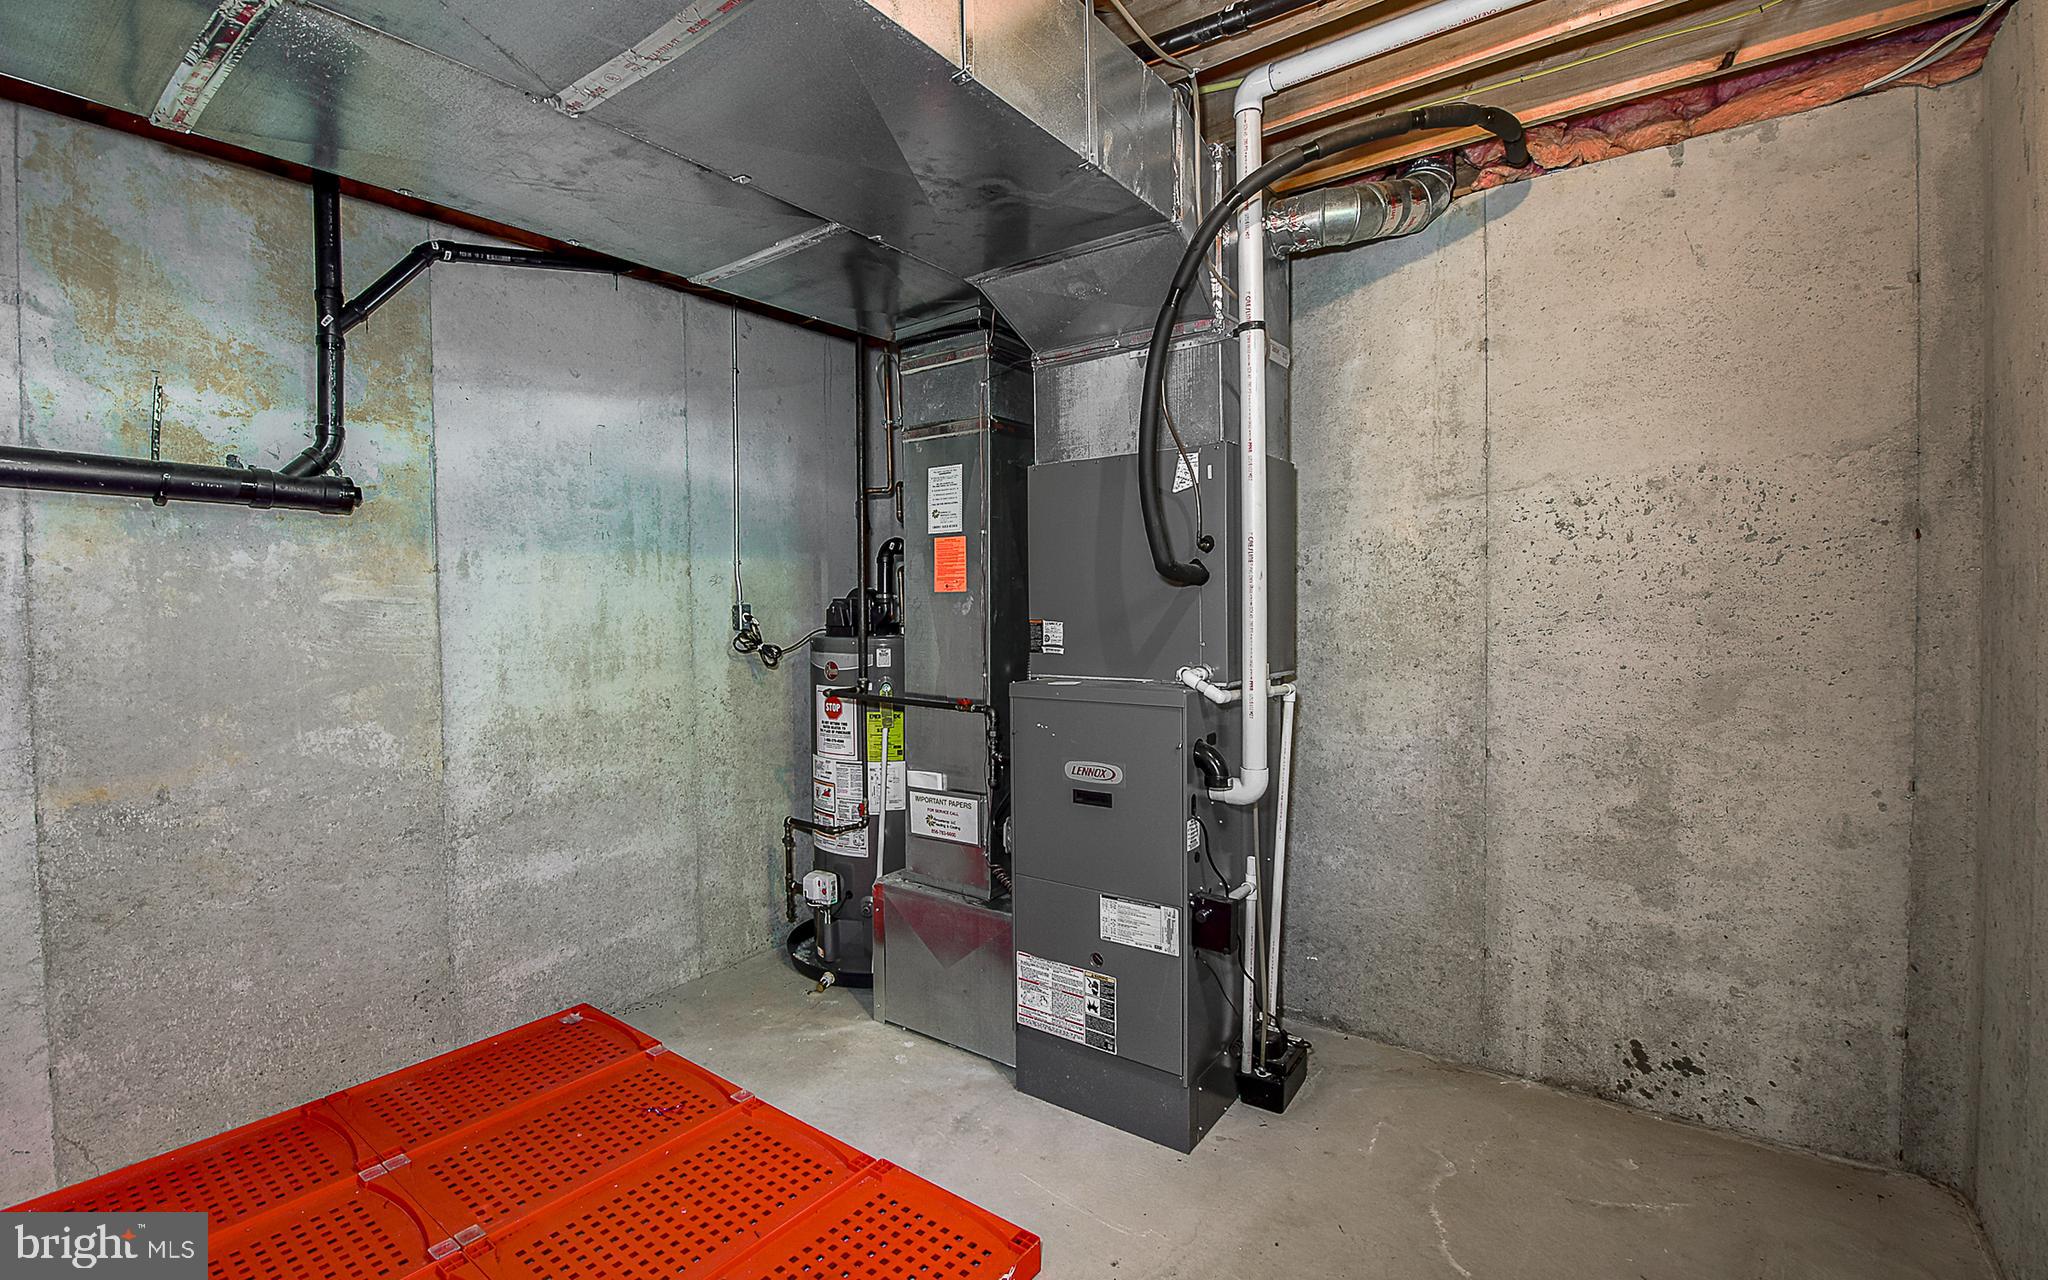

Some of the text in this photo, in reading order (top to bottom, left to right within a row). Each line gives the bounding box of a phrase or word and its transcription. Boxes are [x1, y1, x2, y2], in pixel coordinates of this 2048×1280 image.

[825, 702, 841, 713] STOP
[1071, 765, 1106, 779] LENNOX
[915, 795, 972, 810] IMPORTANT PAPERS
